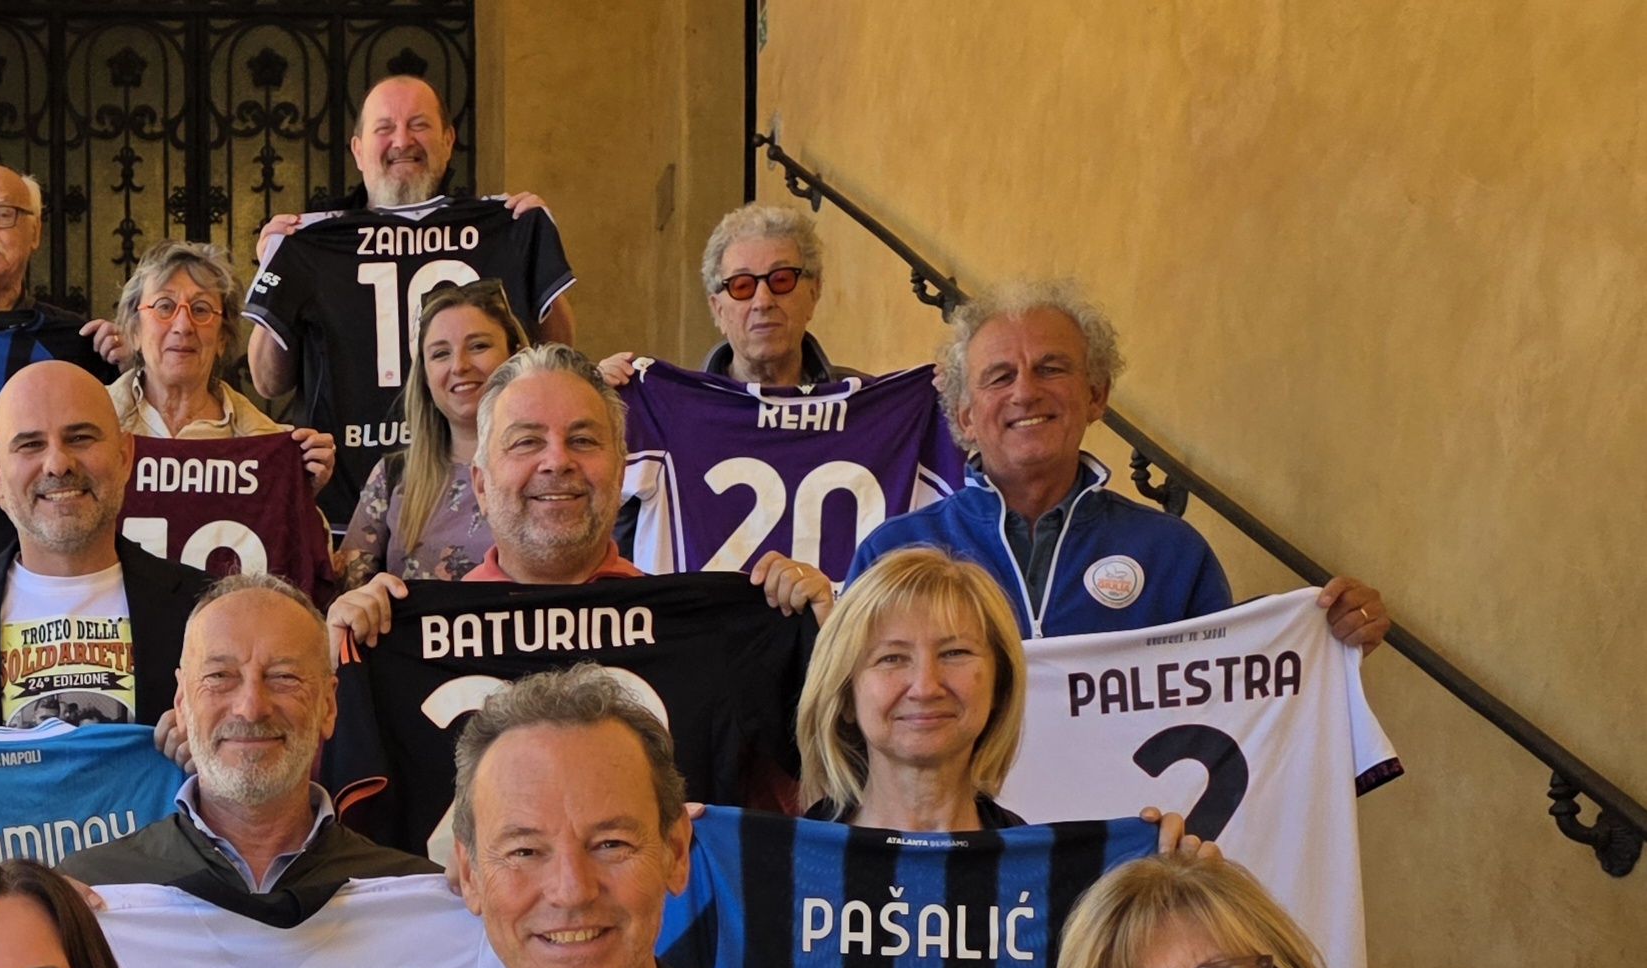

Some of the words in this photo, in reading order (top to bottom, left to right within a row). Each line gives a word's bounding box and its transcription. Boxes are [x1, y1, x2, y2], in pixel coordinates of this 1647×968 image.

[357, 225, 479, 256] ZANIOLO
[136, 456, 259, 495] ADAMS
[703, 456, 886, 600] 20
[21, 618, 72, 645] TROFEO
[76, 620, 120, 639] DELLA
[420, 606, 656, 661] BATURINA
[53, 673, 110, 688] EDIZIONE
[1068, 650, 1302, 717] PALESTRA
[0, 749, 42, 767] NAPOLI
[802, 886, 1035, 960] PAŠALIĆ
